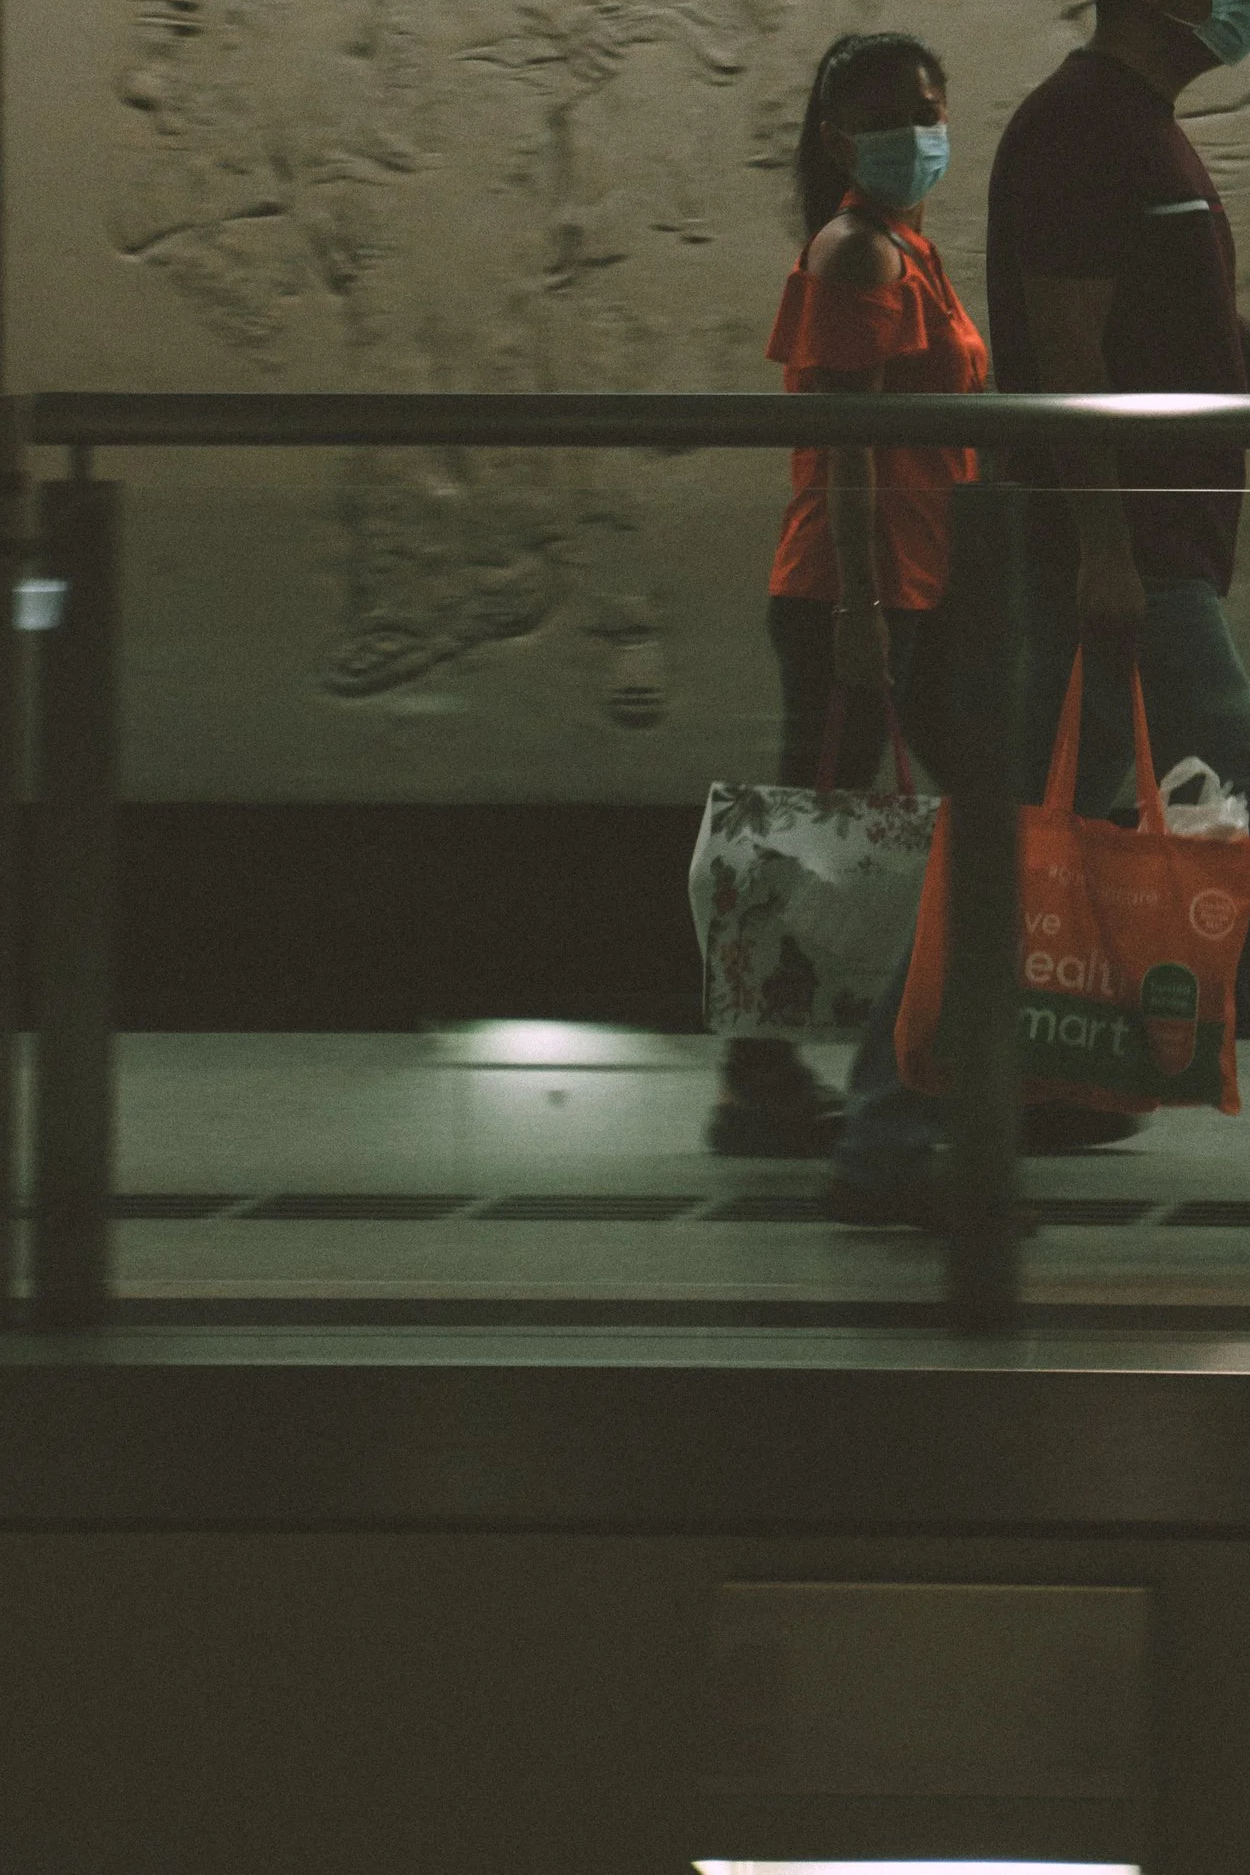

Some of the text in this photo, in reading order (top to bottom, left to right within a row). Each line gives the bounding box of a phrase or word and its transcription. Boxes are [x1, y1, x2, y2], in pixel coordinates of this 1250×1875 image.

[1023, 910, 1062, 937] ve
[1023, 947, 1118, 997] ealt
[1018, 1006, 1130, 1057] mart
